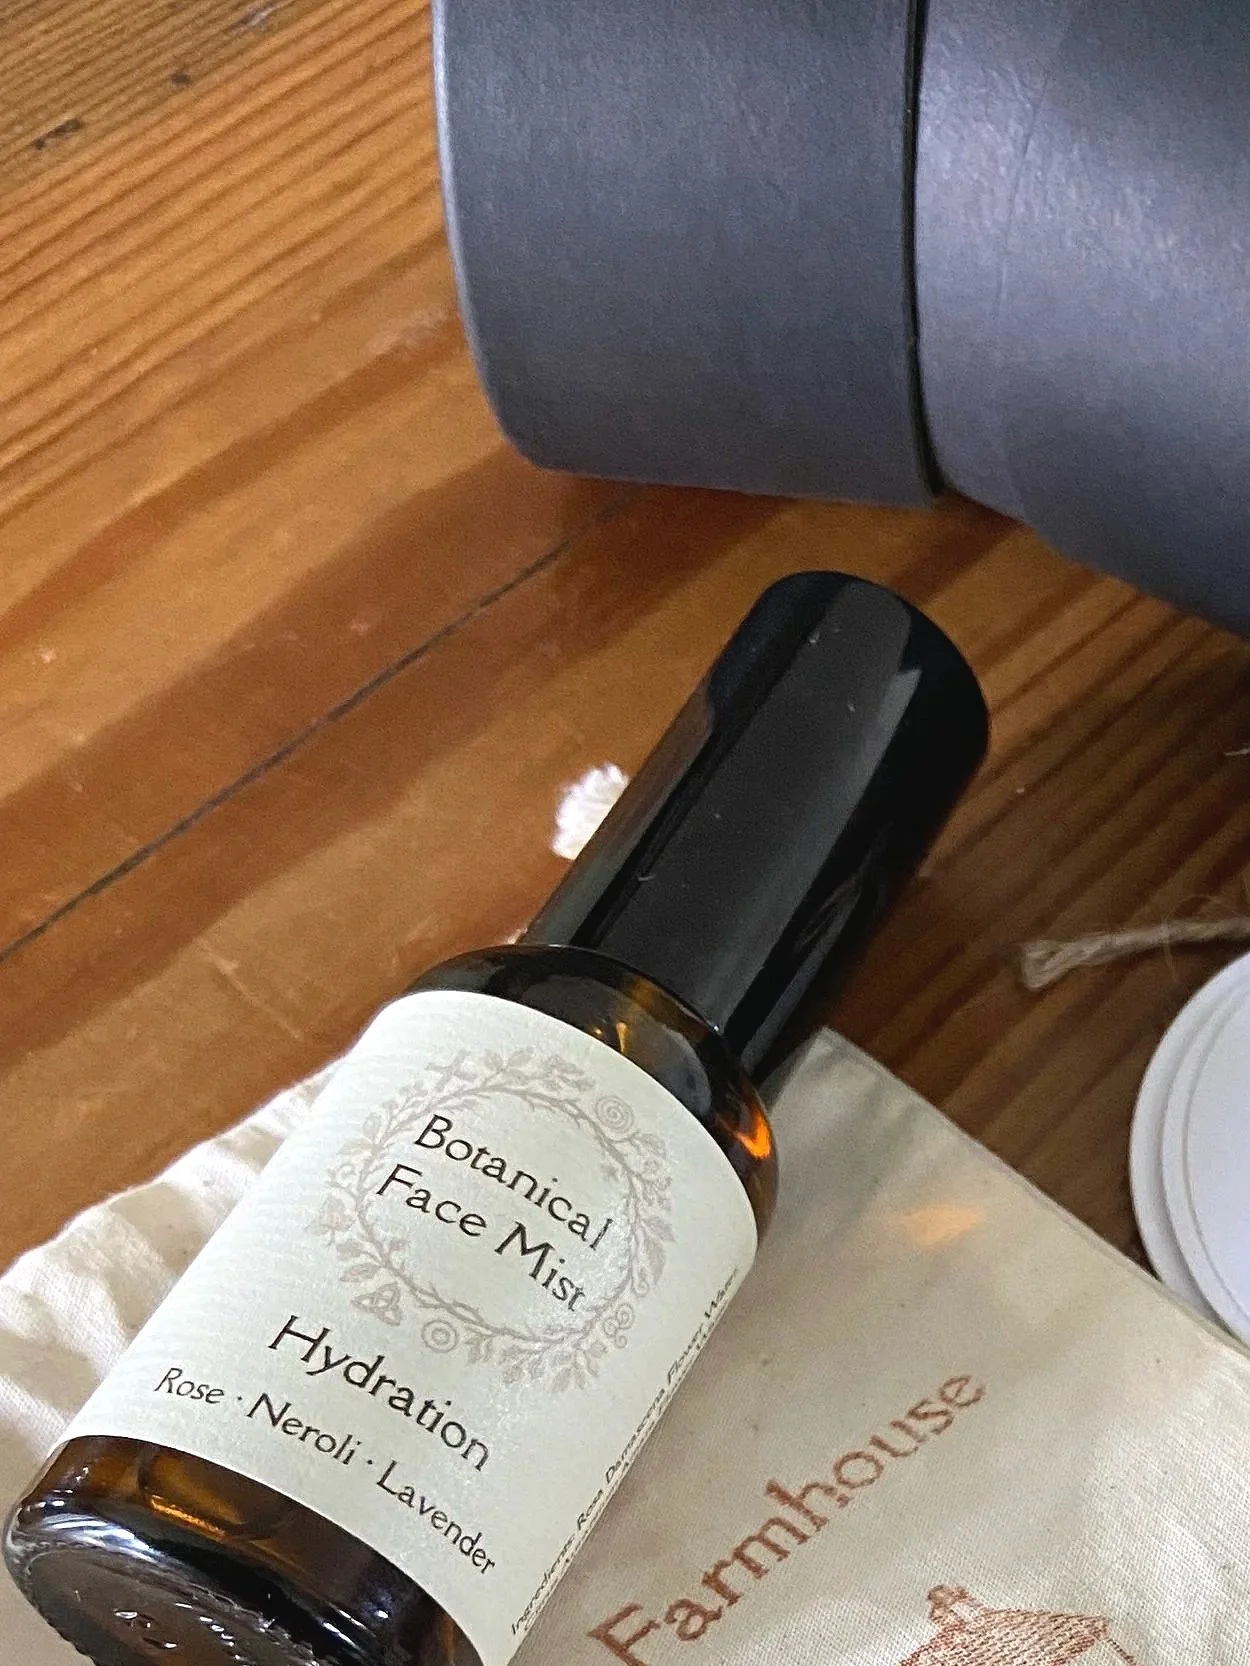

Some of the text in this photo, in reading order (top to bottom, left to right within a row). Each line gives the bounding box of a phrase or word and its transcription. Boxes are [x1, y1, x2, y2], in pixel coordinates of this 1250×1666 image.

[374, 1163, 588, 1314] Face Mist
[412, 1113, 616, 1253] Botanical
[266, 1313, 494, 1472] Hydration
[153, 1365, 497, 1576] Rose Neroli Lavender
